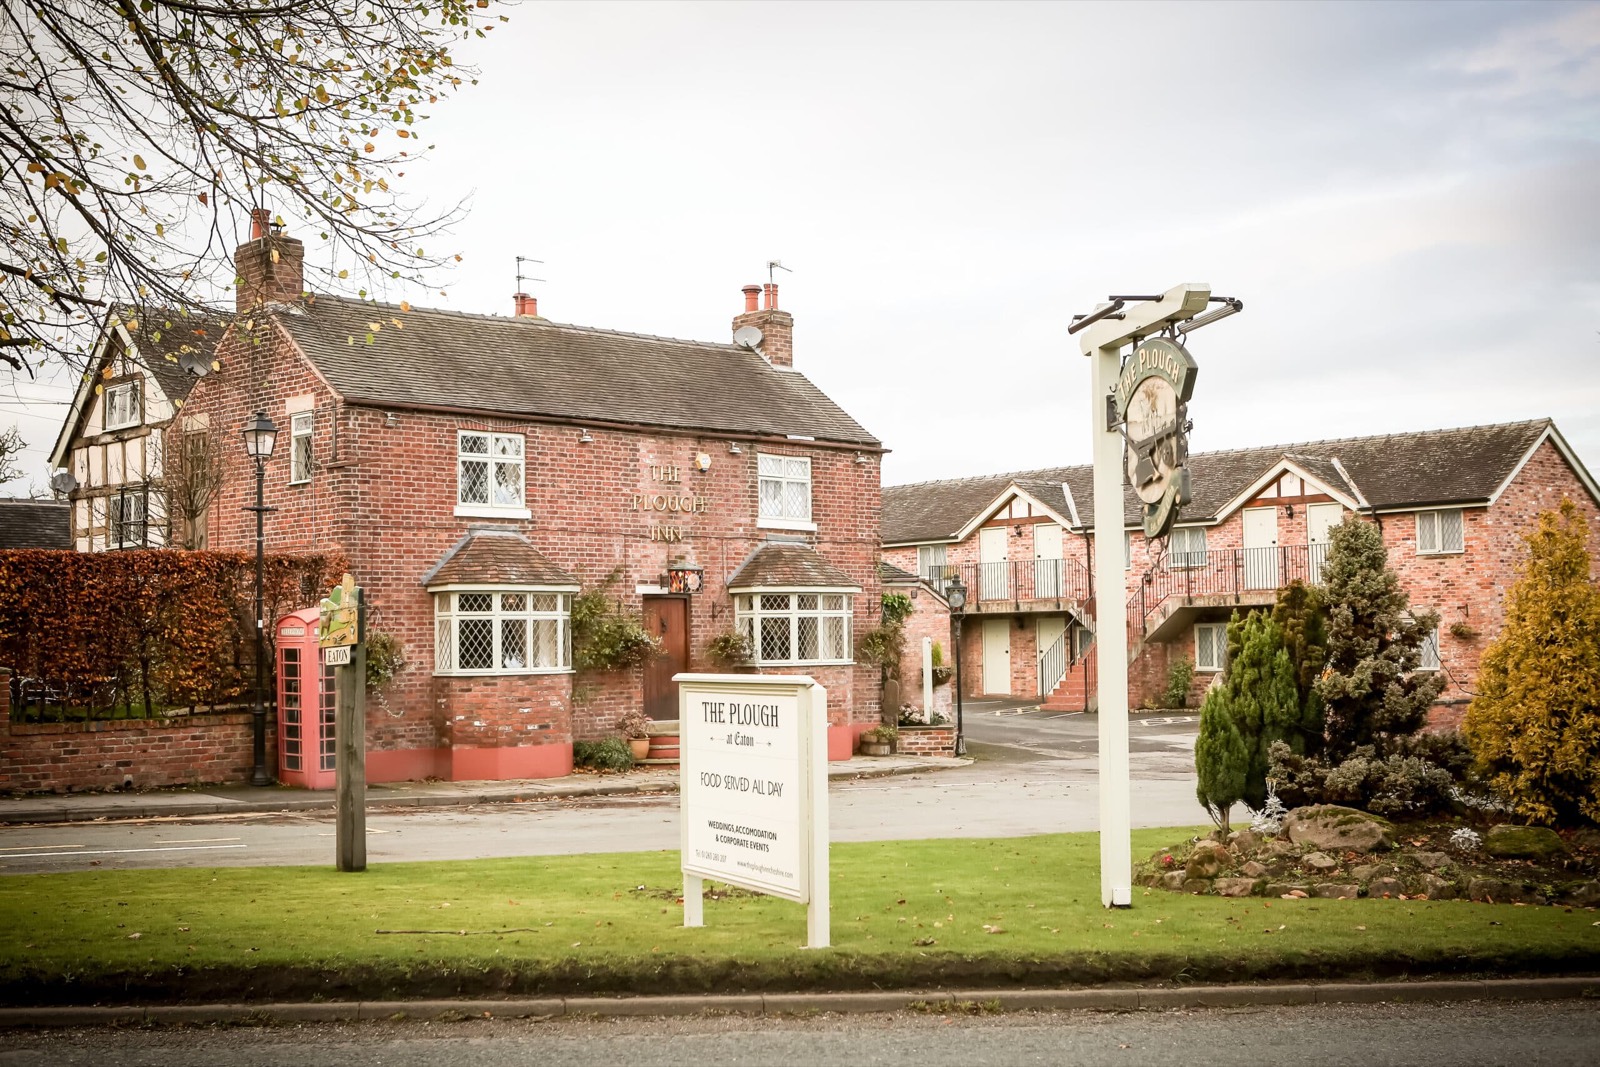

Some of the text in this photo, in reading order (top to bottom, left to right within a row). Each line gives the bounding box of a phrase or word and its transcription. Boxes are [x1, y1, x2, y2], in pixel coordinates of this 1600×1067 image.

[1119, 348, 1180, 401] THE PLOUGH
[650, 465, 682, 483] THE
[632, 494, 706, 513] PLOUGH
[650, 525, 682, 542] INN
[327, 648, 349, 663] EATON
[702, 701, 779, 727] THE PLOUGH
[726, 731, 754, 746] at Eaton
[700, 771, 784, 797] FOOD SERVED ALL DAY
[719, 834, 749, 849] CORPORATE
[749, 840, 770, 853] EVENTS
